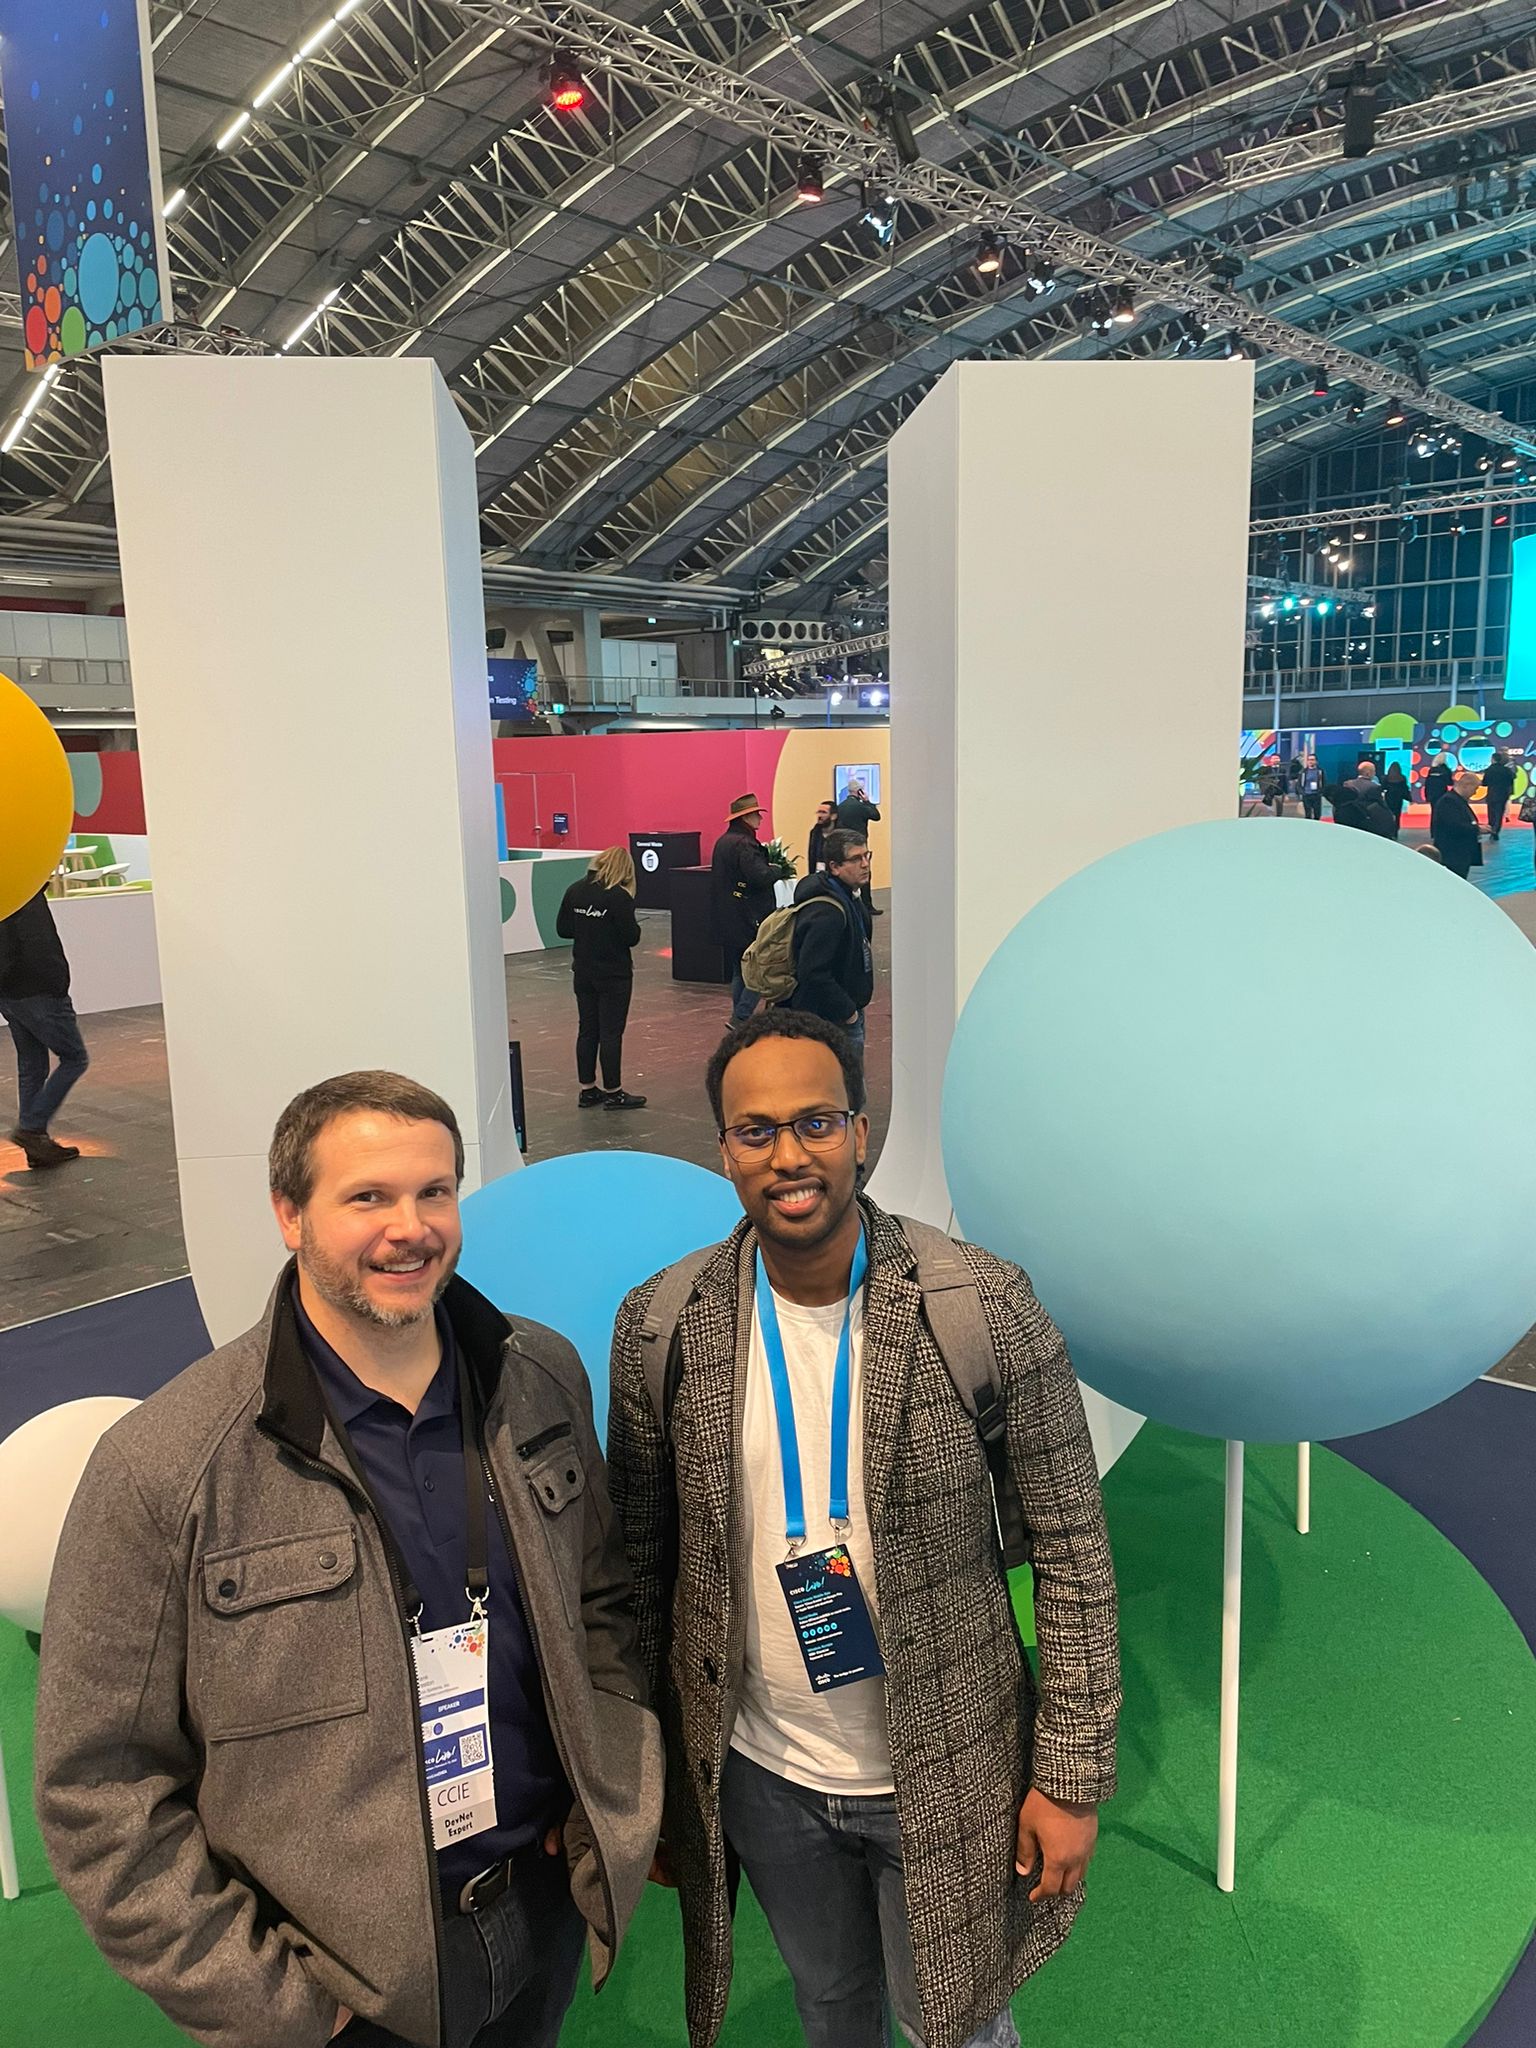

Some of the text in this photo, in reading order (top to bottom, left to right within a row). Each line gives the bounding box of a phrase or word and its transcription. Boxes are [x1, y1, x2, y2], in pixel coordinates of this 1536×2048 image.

[495, 696, 517, 706] Testing
[438, 1701, 460, 1713] SPEAKER
[437, 1782, 470, 1807] CCIE
[445, 1811, 474, 1828] DevNet
[448, 1822, 473, 1838] Expert
